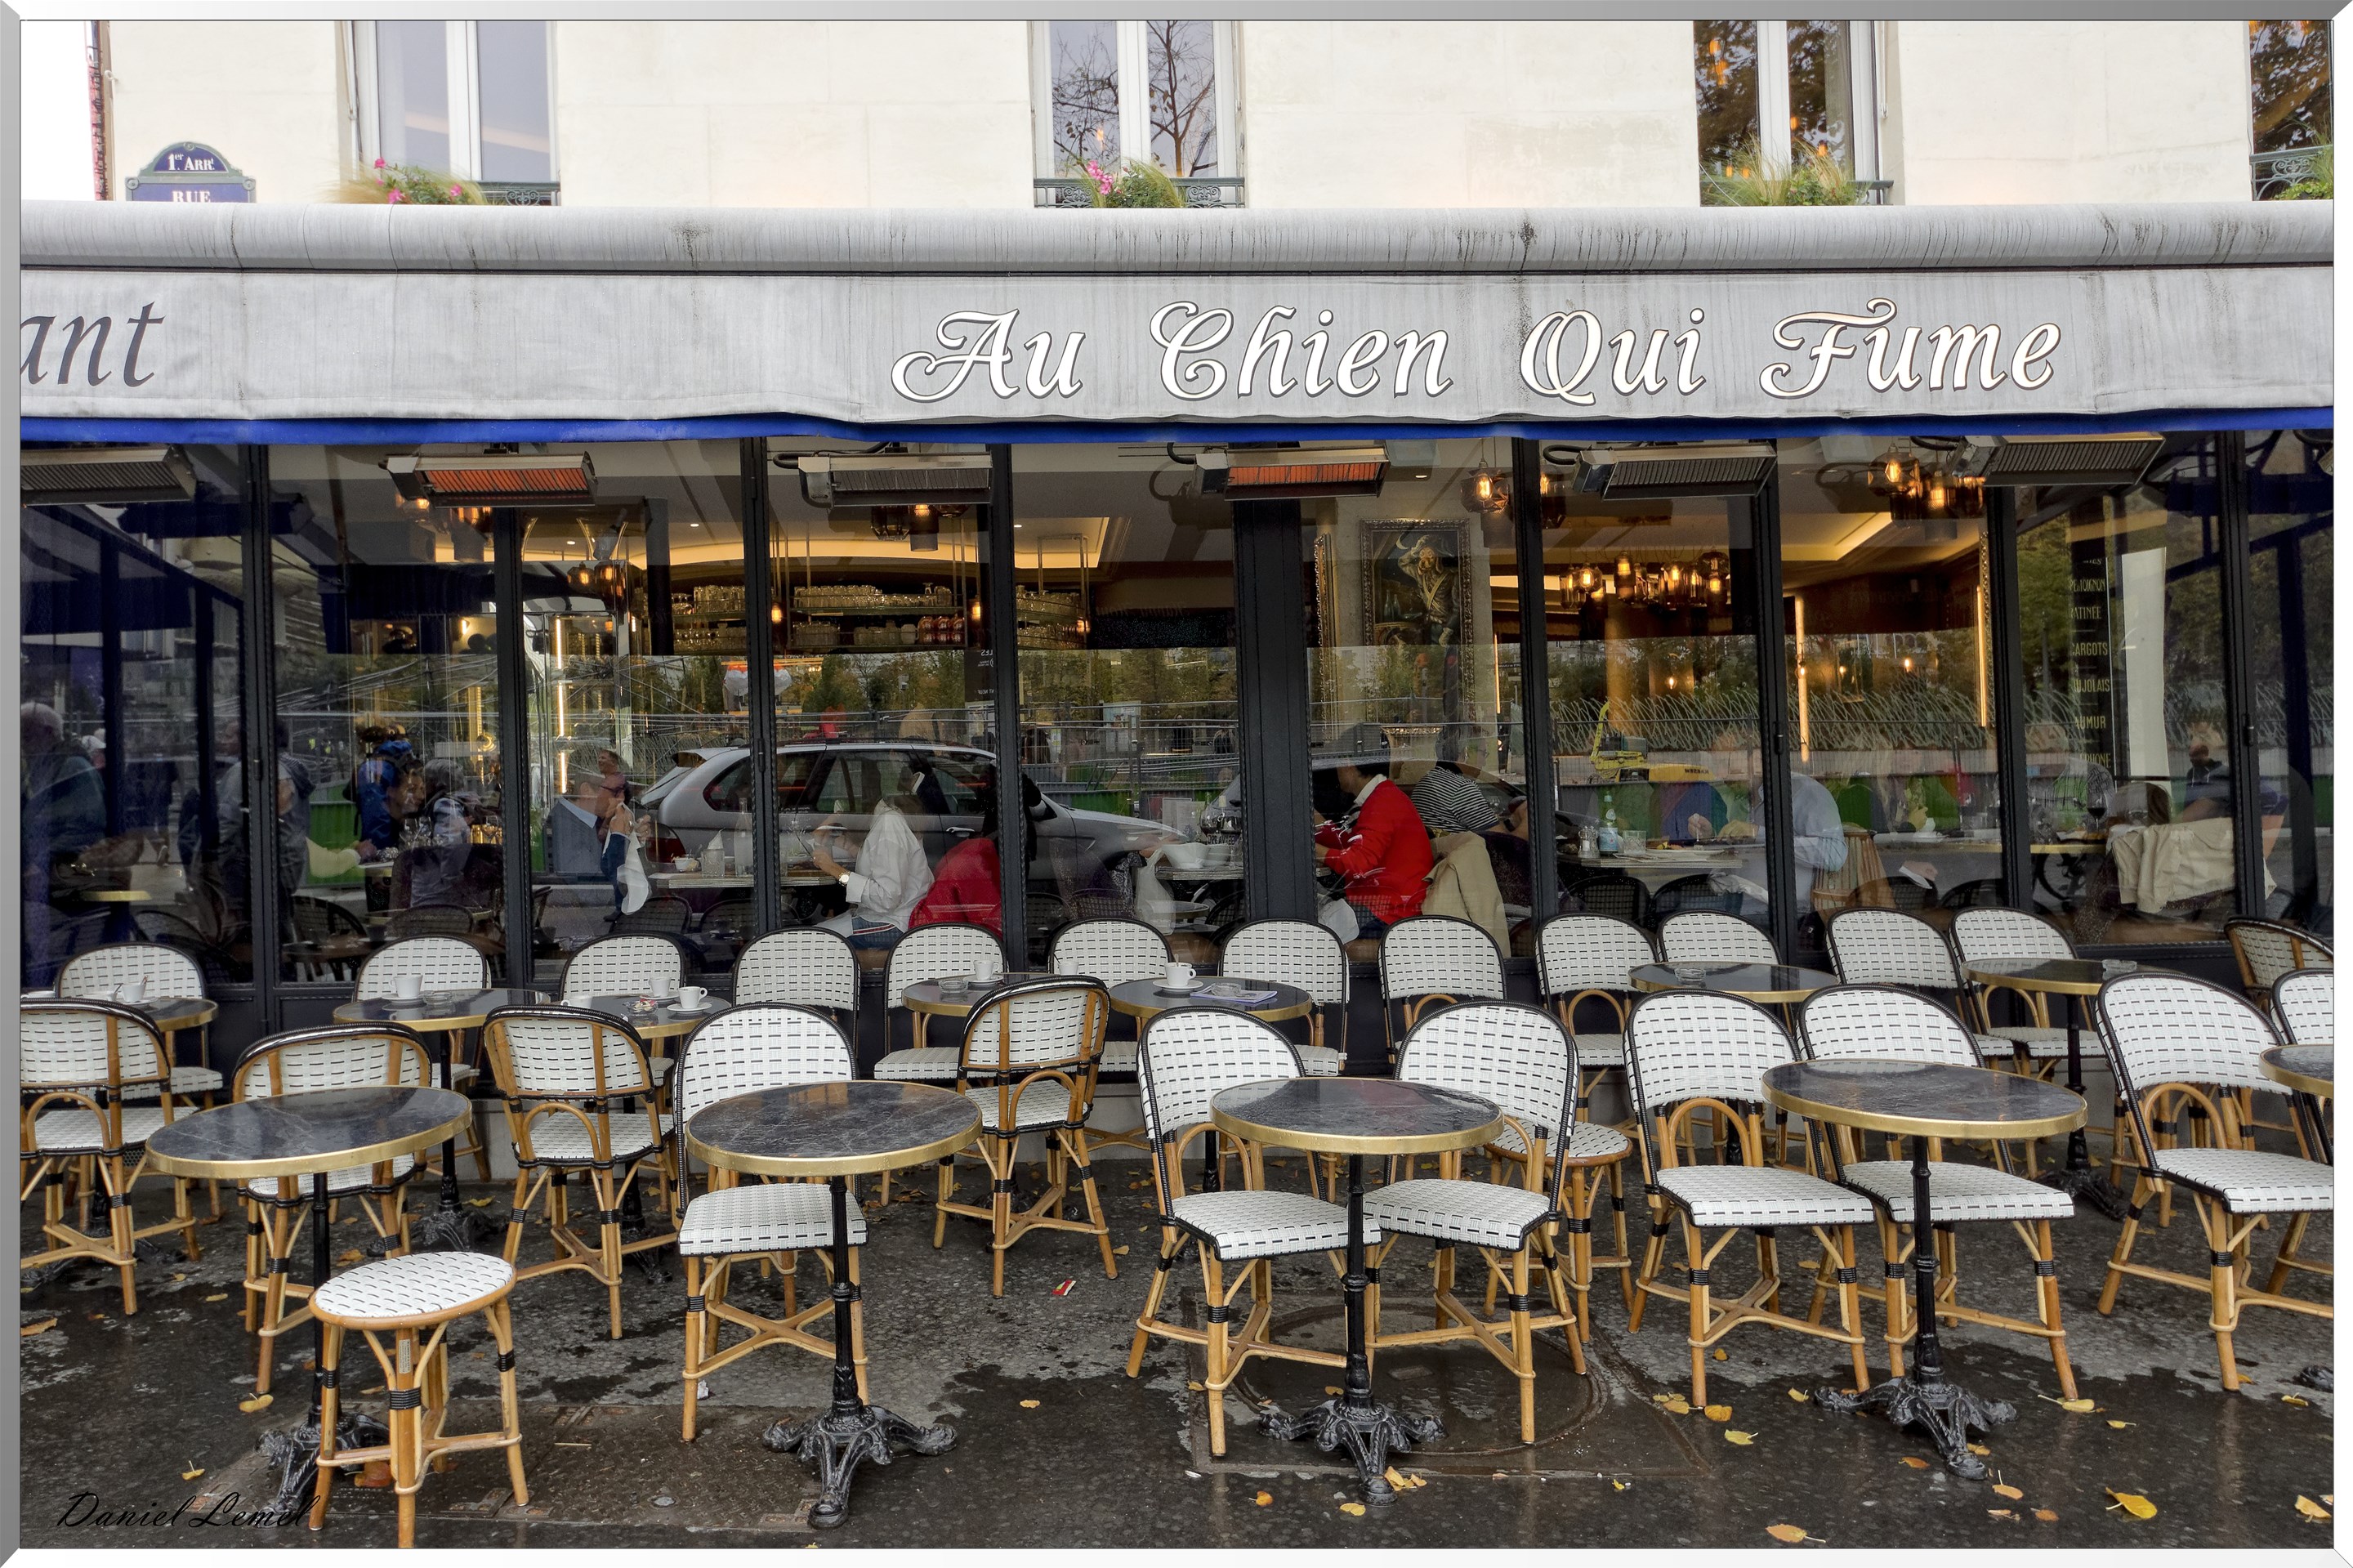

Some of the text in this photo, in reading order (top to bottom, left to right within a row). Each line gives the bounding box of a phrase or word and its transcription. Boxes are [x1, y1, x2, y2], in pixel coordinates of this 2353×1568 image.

[172, 190, 211, 203] RUE
[20, 302, 166, 387] ant
[891, 297, 2061, 406] Au Chien Qui Fume
